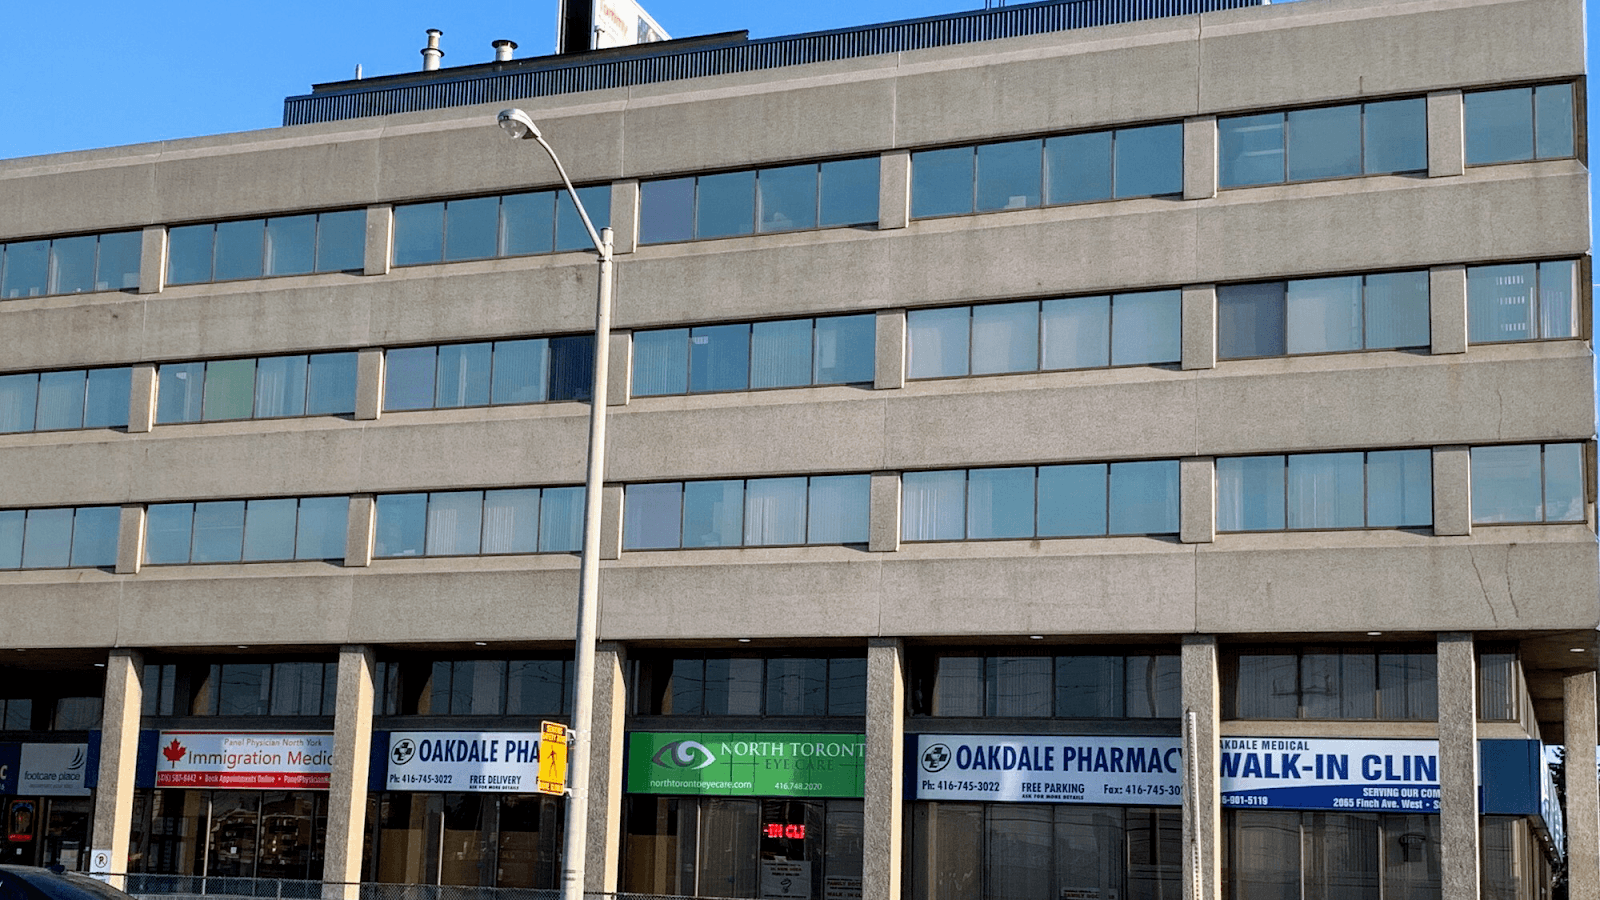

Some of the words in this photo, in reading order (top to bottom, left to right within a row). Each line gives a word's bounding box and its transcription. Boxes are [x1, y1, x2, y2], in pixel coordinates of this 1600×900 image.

[224, 738, 245, 746] Panel
[246, 738, 280, 748] Physician
[282, 738, 304, 747] North
[306, 738, 323, 747] York
[1261, 741, 1310, 751] MEDICAL
[419, 739, 499, 762] OAKDALE
[504, 740, 540, 763] PHA
[721, 741, 784, 756] NORTH
[789, 742, 867, 758] TORONT
[188, 749, 281, 769] Immigration
[765, 759, 790, 770] EYE
[795, 759, 834, 771] CARE
[956, 745, 1055, 771] OAKDALE
[1063, 746, 1182, 774] PHARMAC
[1220, 752, 1348, 780] WALK-IN
[1361, 754, 1437, 781] CLIN
[24, 771, 58, 781] footcare
[58, 771, 81, 783] place
[390, 773, 400, 783] Ph:
[401, 774, 453, 784] 416-745-3022
[469, 775, 486, 785] FREE
[487, 775, 522, 785] DELIVERY
[650, 779, 752, 790] northtorontoeyecare.com
[774, 782, 823, 791] 416.748.2020
[922, 780, 935, 790] Ph:
[937, 781, 1000, 792] 416-745-3022
[1021, 782, 1042, 793] FREE
[1044, 782, 1085, 794] PARKING
[1103, 784, 1123, 794] Fax:
[1125, 784, 1182, 796] 416-745-30
[1362, 787, 1400, 798] SERVING
[1401, 788, 1419, 798] OUR
[1333, 798, 1355, 808] 2065
[1356, 798, 1380, 809] Finch
[1380, 798, 1400, 809] Ave.
[1401, 799, 1423, 810] West
